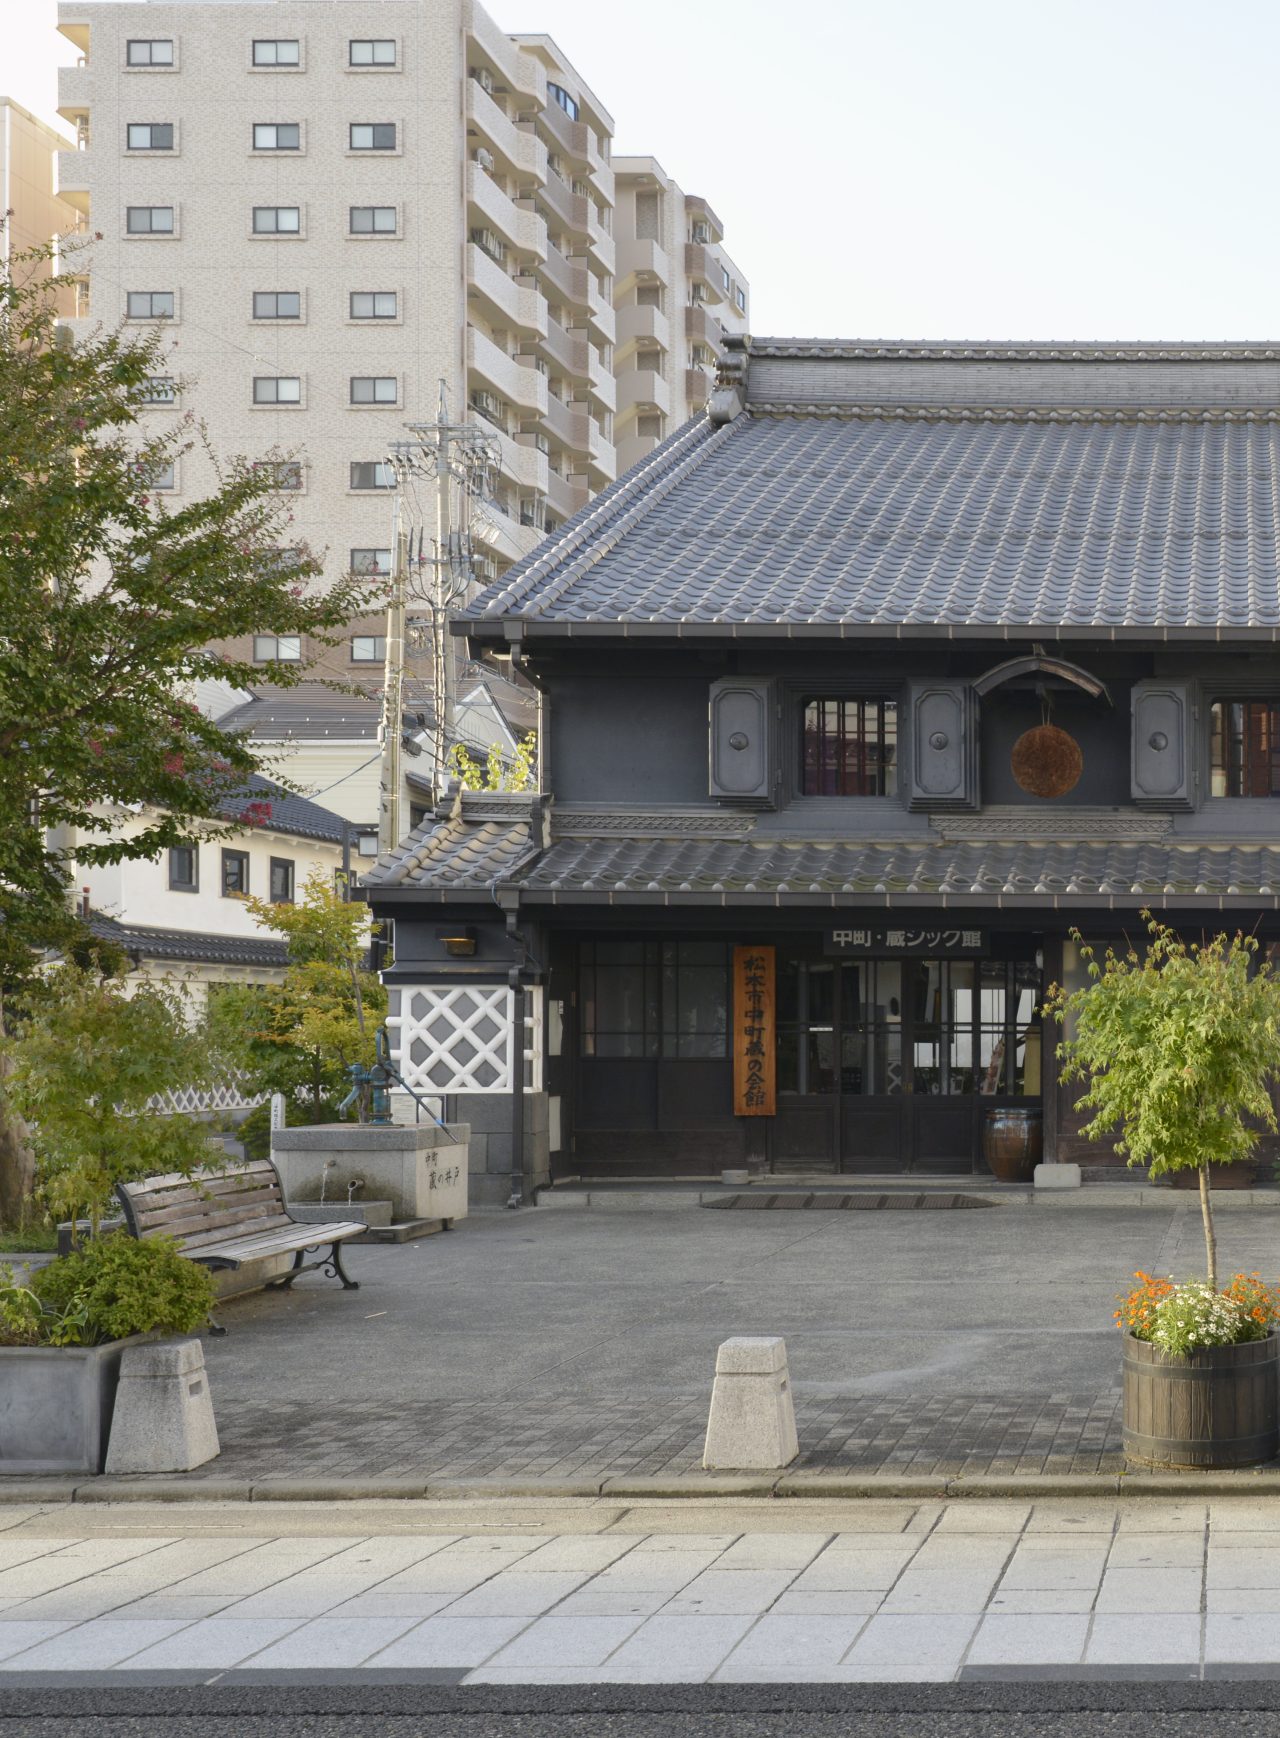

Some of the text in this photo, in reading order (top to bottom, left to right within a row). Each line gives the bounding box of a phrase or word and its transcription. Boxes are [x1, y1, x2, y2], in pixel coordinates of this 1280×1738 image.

[743, 955, 766, 1107] 松本市中町蔵の会館
